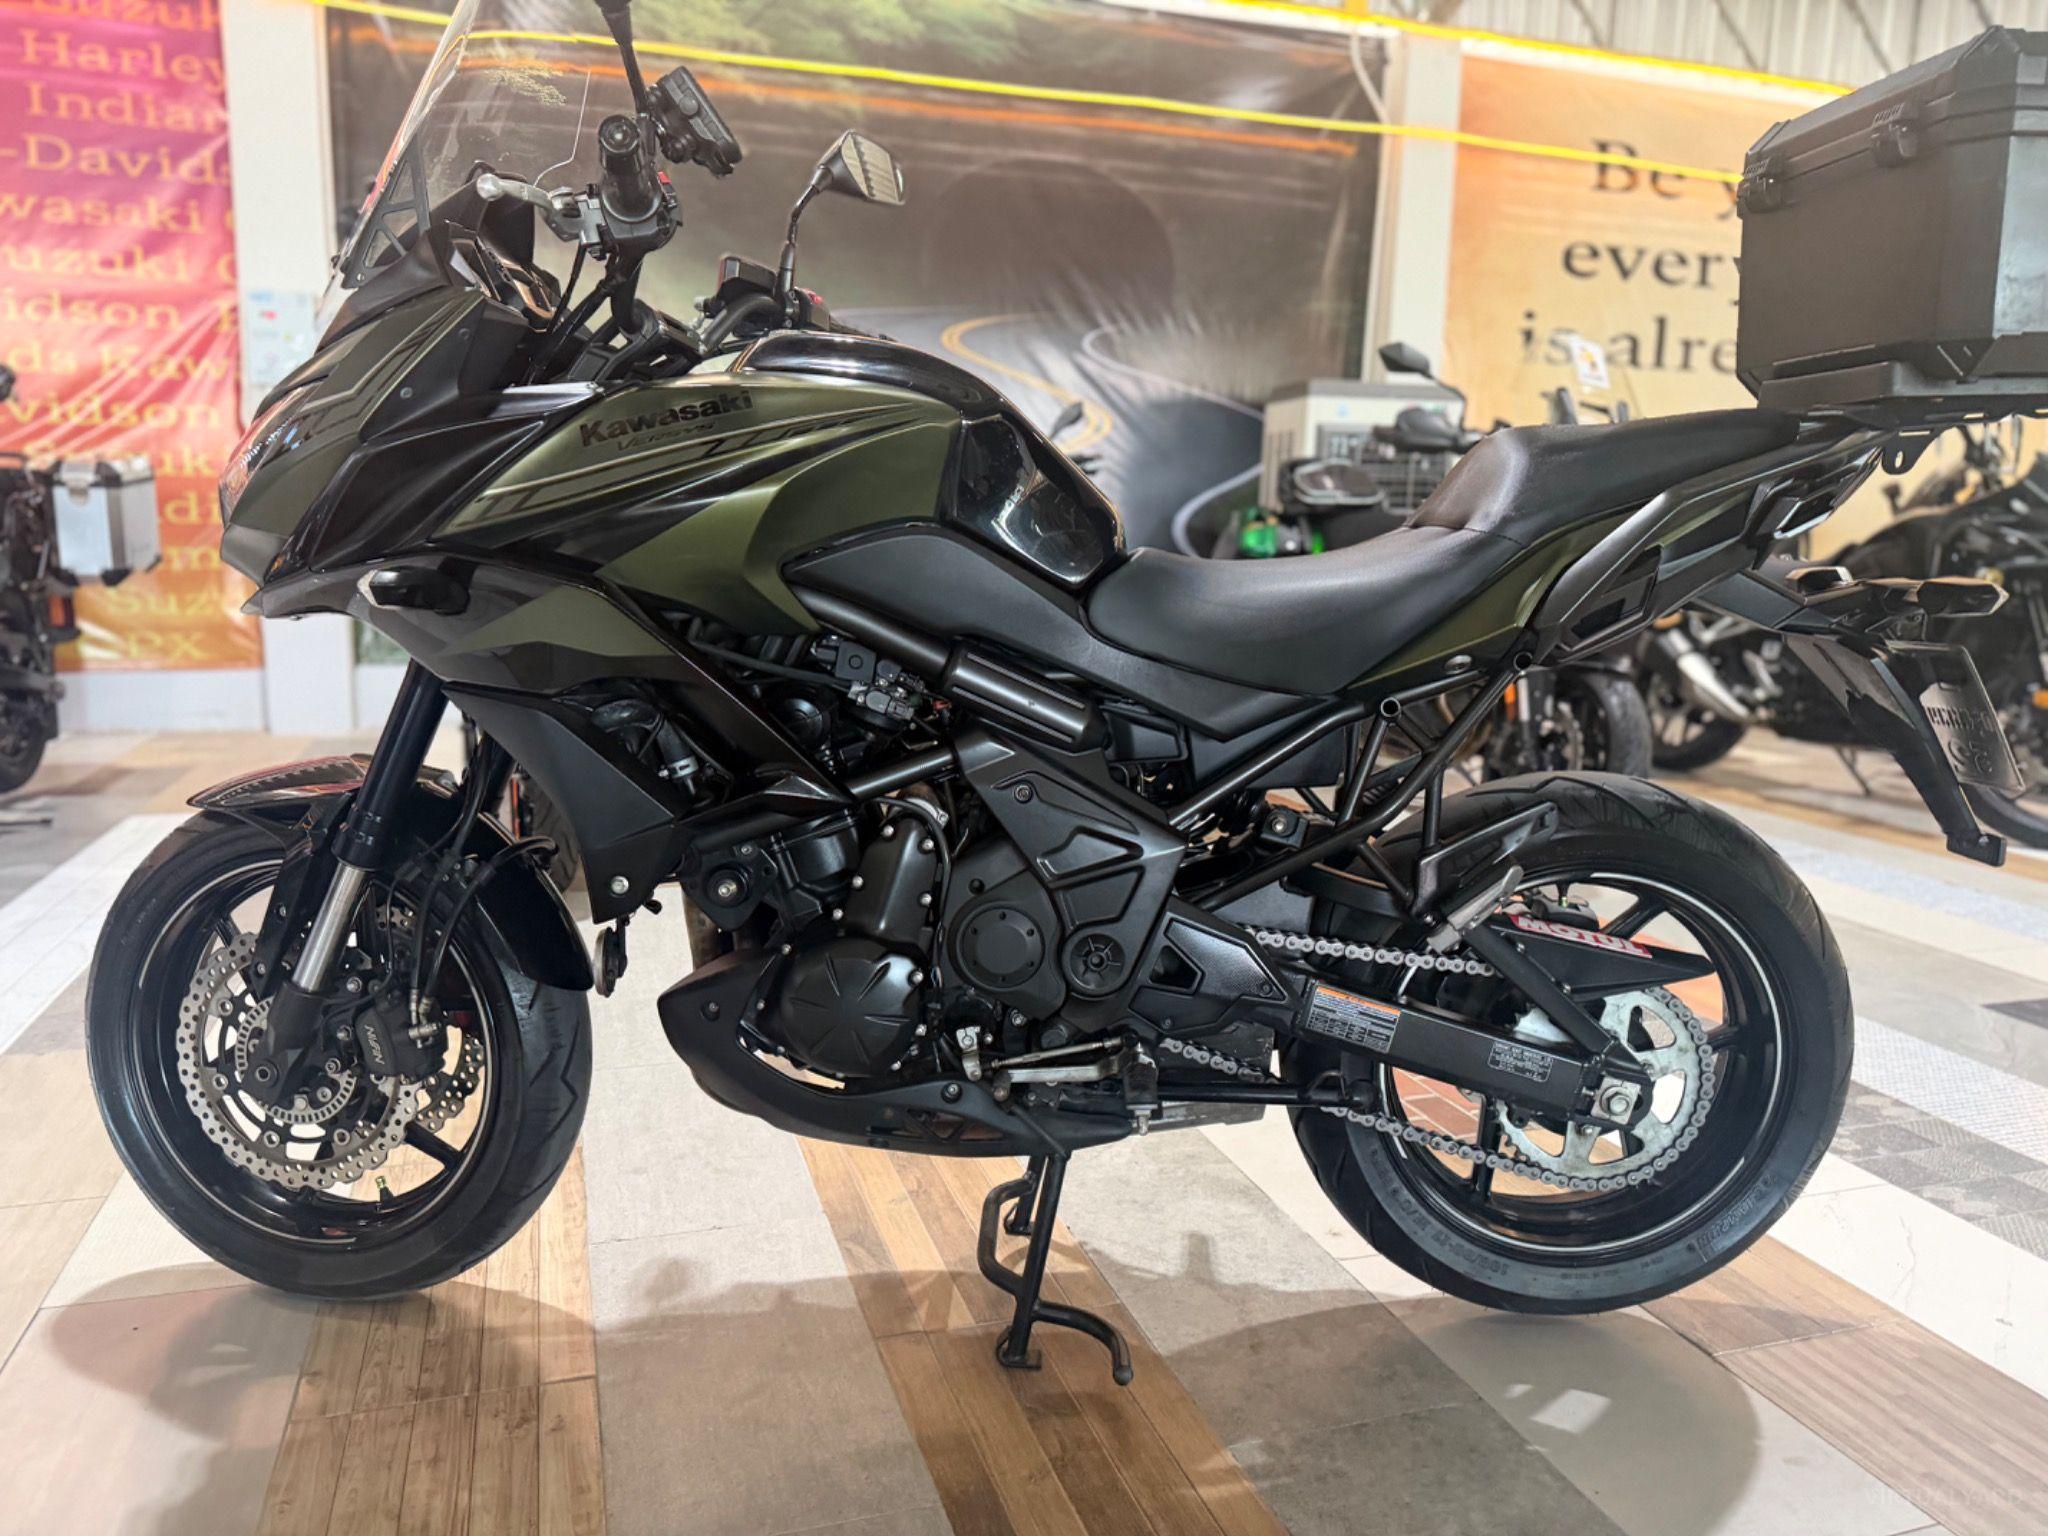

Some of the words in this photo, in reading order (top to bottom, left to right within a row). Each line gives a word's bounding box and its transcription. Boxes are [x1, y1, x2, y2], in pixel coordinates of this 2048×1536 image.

[18, 27, 224, 94] Harley
[1592, 138, 1688, 199] Be
[579, 391, 754, 447] Kawasaki
[1518, 916, 1649, 956] MOTUL
